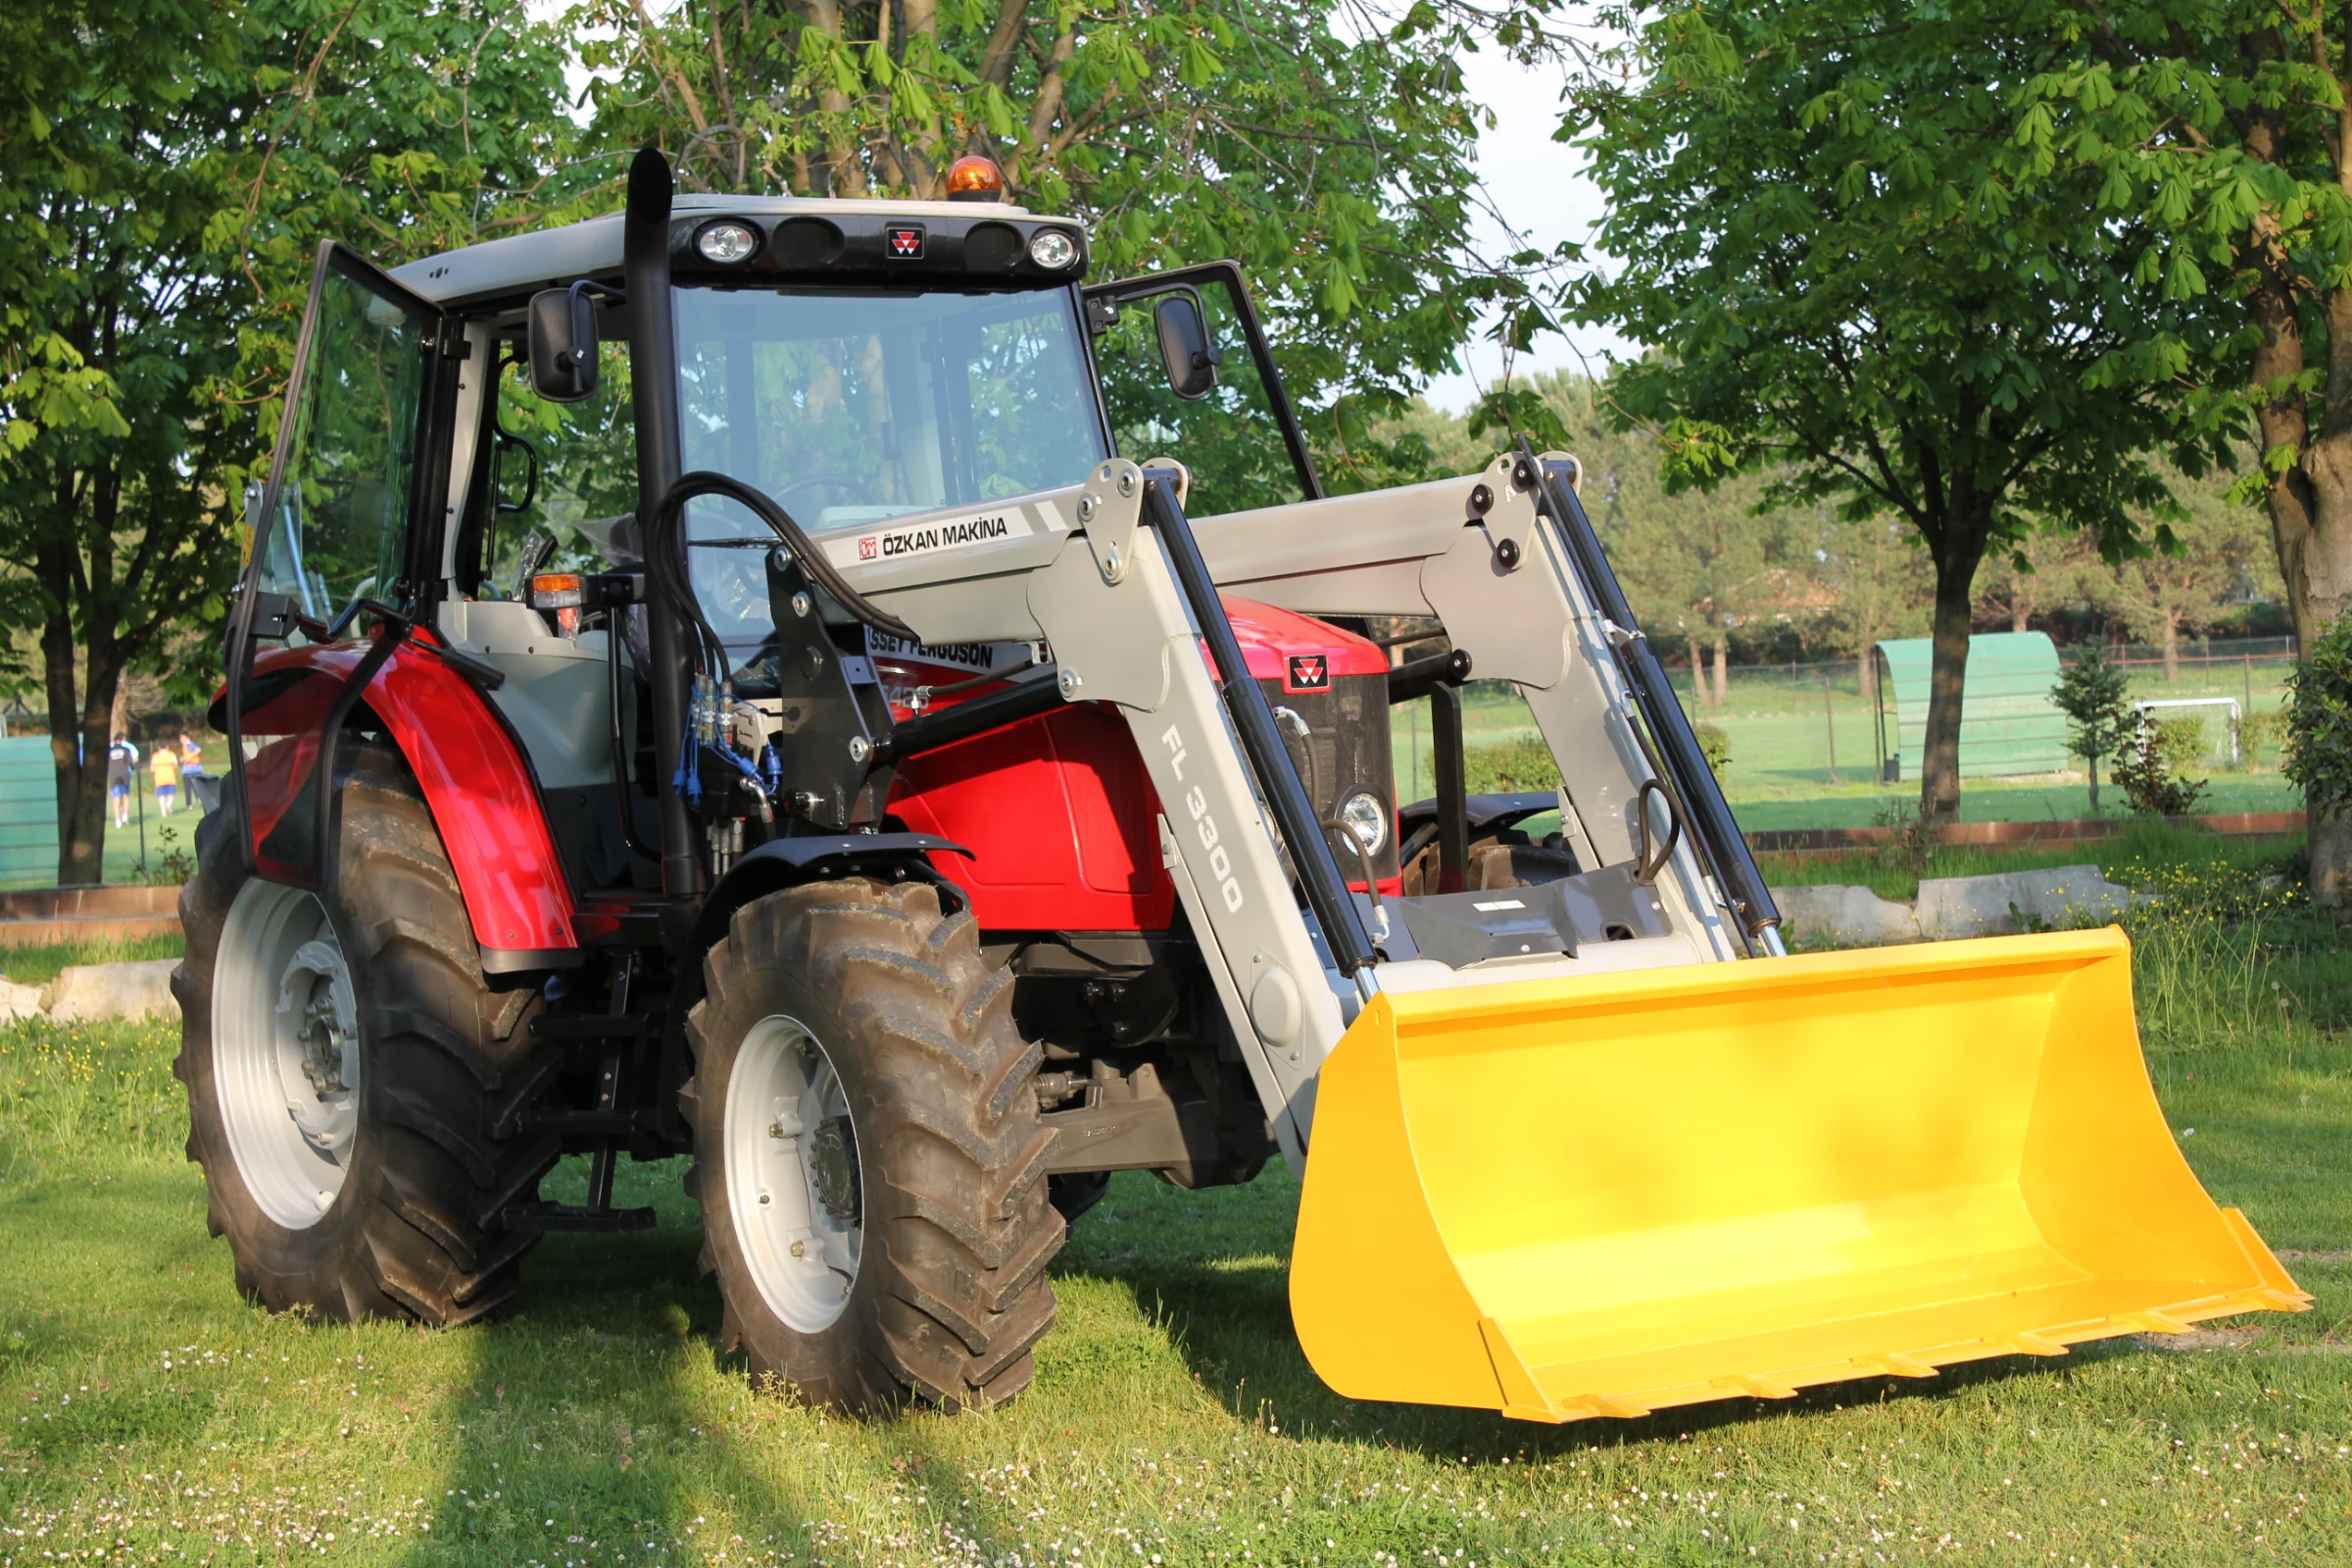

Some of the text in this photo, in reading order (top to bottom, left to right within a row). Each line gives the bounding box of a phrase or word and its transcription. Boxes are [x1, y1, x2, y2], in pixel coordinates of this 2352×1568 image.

[883, 529, 938, 556] ÖZKAN
[942, 516, 1007, 546] MAKİNA
[870, 628, 904, 654] SSEY
[1161, 723, 1244, 913] FL 3300
